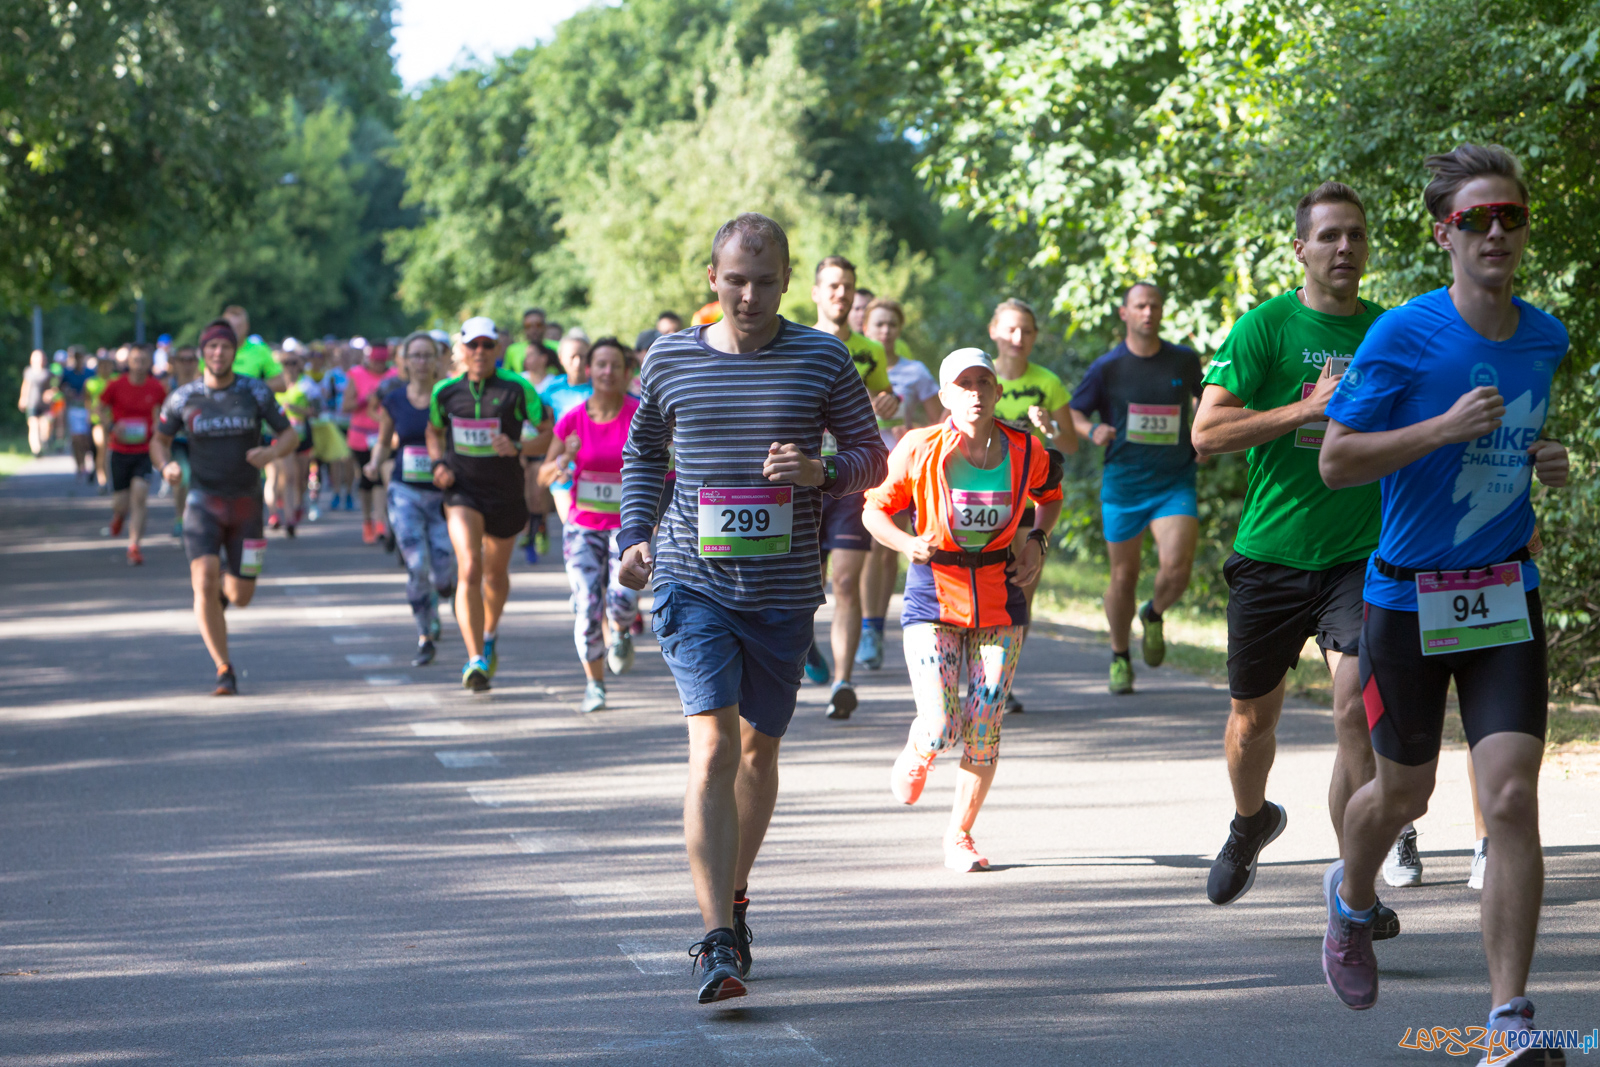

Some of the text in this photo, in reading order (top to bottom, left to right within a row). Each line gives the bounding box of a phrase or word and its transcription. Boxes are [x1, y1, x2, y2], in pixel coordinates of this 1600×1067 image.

[1140, 416, 1168, 430] 233
[463, 430, 489, 443] 115
[1476, 426, 1537, 451] BIKE
[1461, 452, 1535, 468] CHALLEN
[594, 485, 613, 499] 10
[720, 508, 771, 533] 299
[960, 508, 999, 527] 340
[1452, 591, 1490, 622] 94
